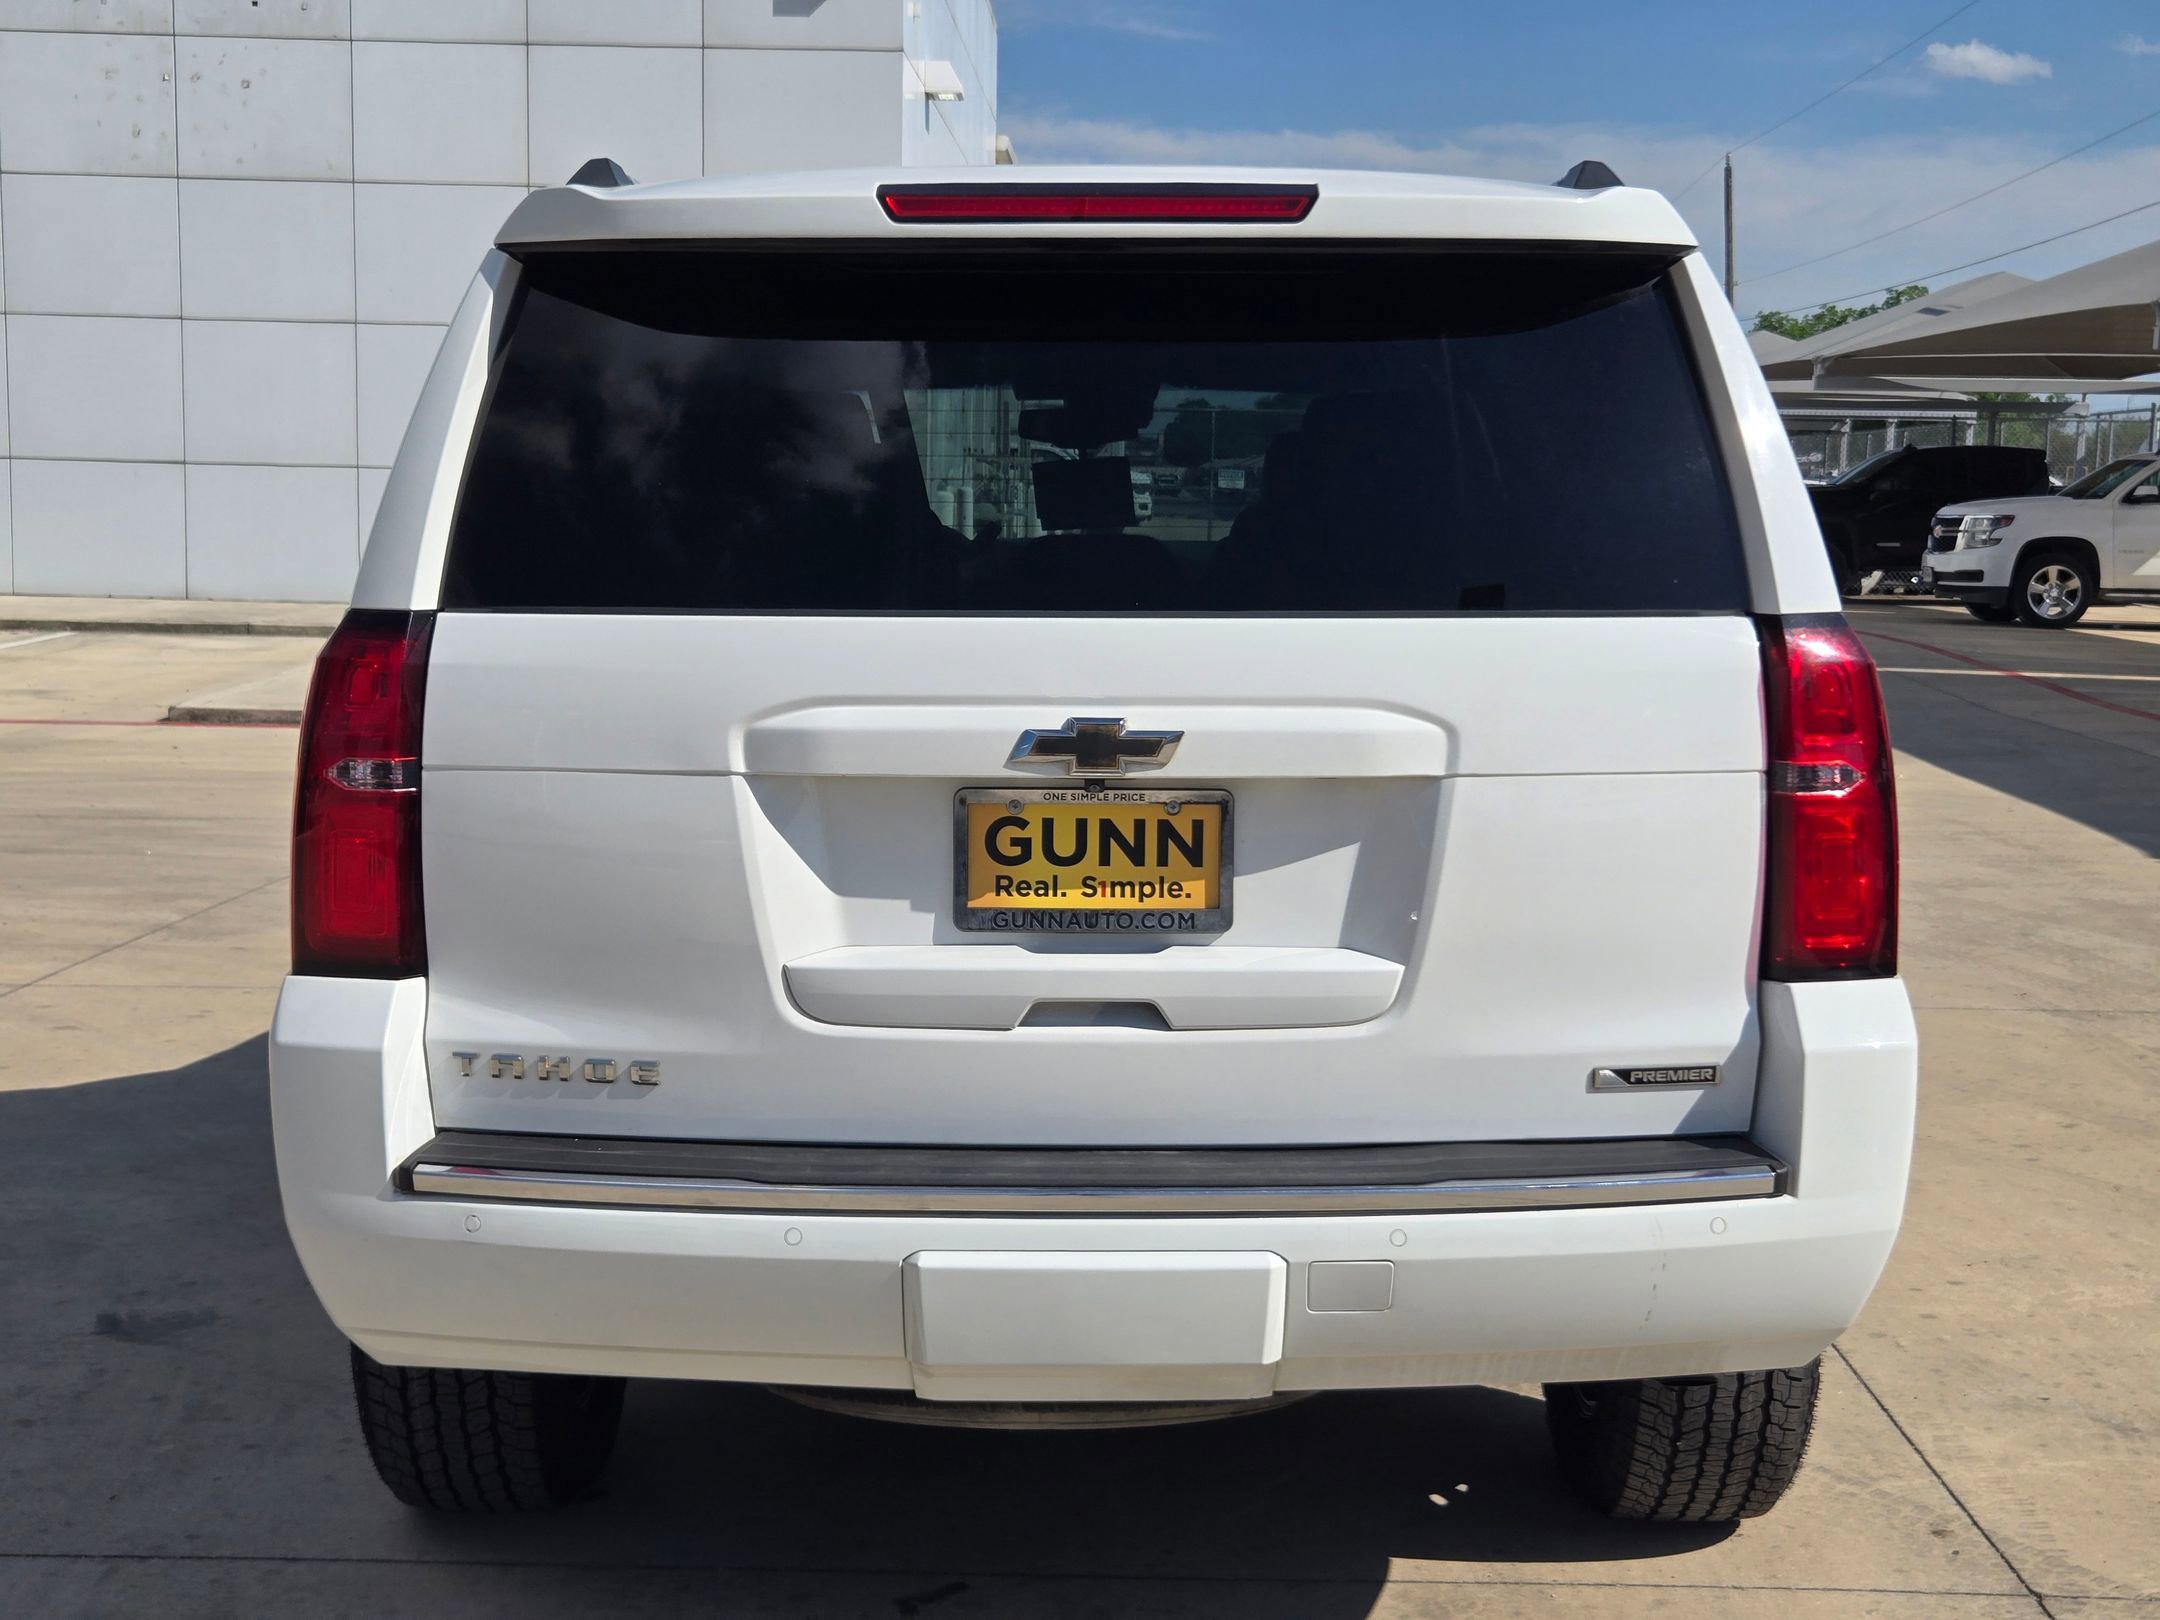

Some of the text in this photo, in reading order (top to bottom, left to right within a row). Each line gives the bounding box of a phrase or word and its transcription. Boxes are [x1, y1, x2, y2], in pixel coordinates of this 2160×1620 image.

[1043, 792, 1146, 802] ONE SIMPLE PRICE
[984, 816, 1204, 867] GUNN
[995, 875, 1067, 898] Real.
[992, 912, 1196, 930] GUNNAUTO.COM
[452, 1052, 660, 1086] TAHOE
[1630, 1068, 1715, 1083] PREMIER
